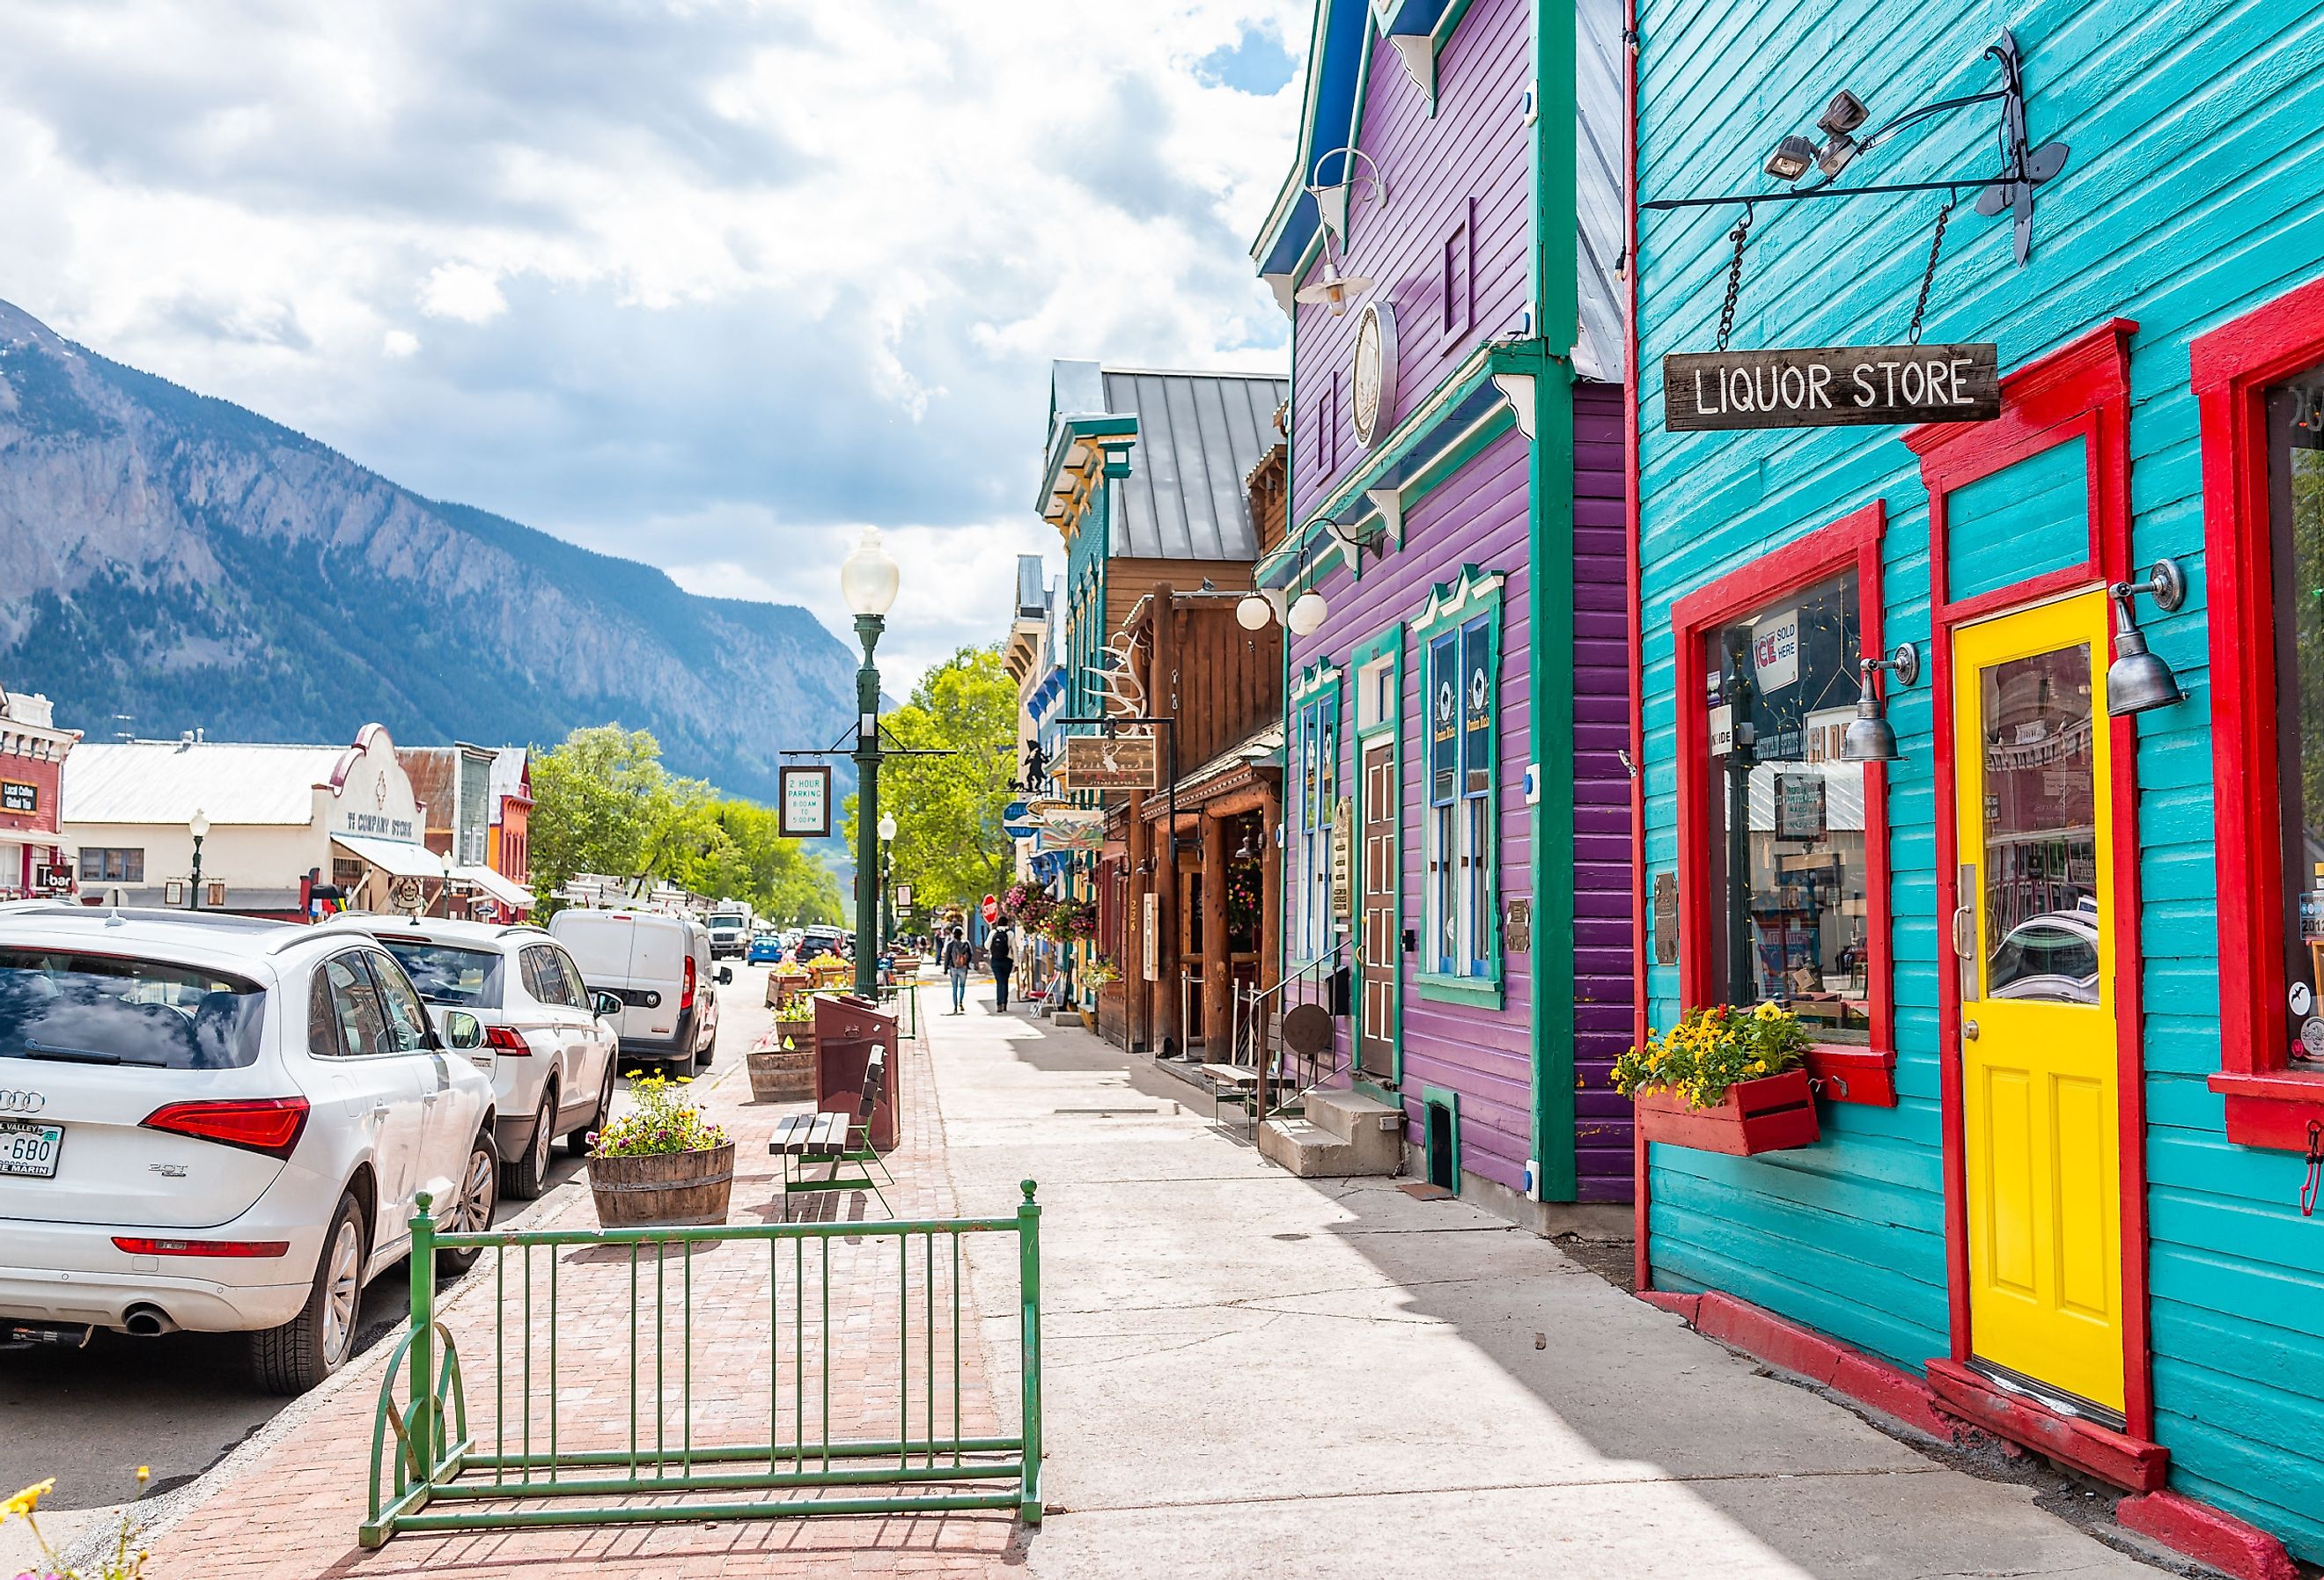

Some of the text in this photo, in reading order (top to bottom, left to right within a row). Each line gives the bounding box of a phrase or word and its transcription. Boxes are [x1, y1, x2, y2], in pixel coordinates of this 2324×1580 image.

[1695, 358, 1975, 415] LIQUOR STORE
[1776, 624, 1796, 642] SOLD
[1754, 633, 1776, 670] ICE
[1777, 643, 1796, 660] HERE
[358, 813, 389, 834] COMPANY
[392, 819, 412, 838] STORE
[39, 866, 71, 887] T-bar
[983, 902, 997, 914] STOP
[6, 1123, 38, 1134] VALLEY
[11, 1165, 48, 1175] MARIN
